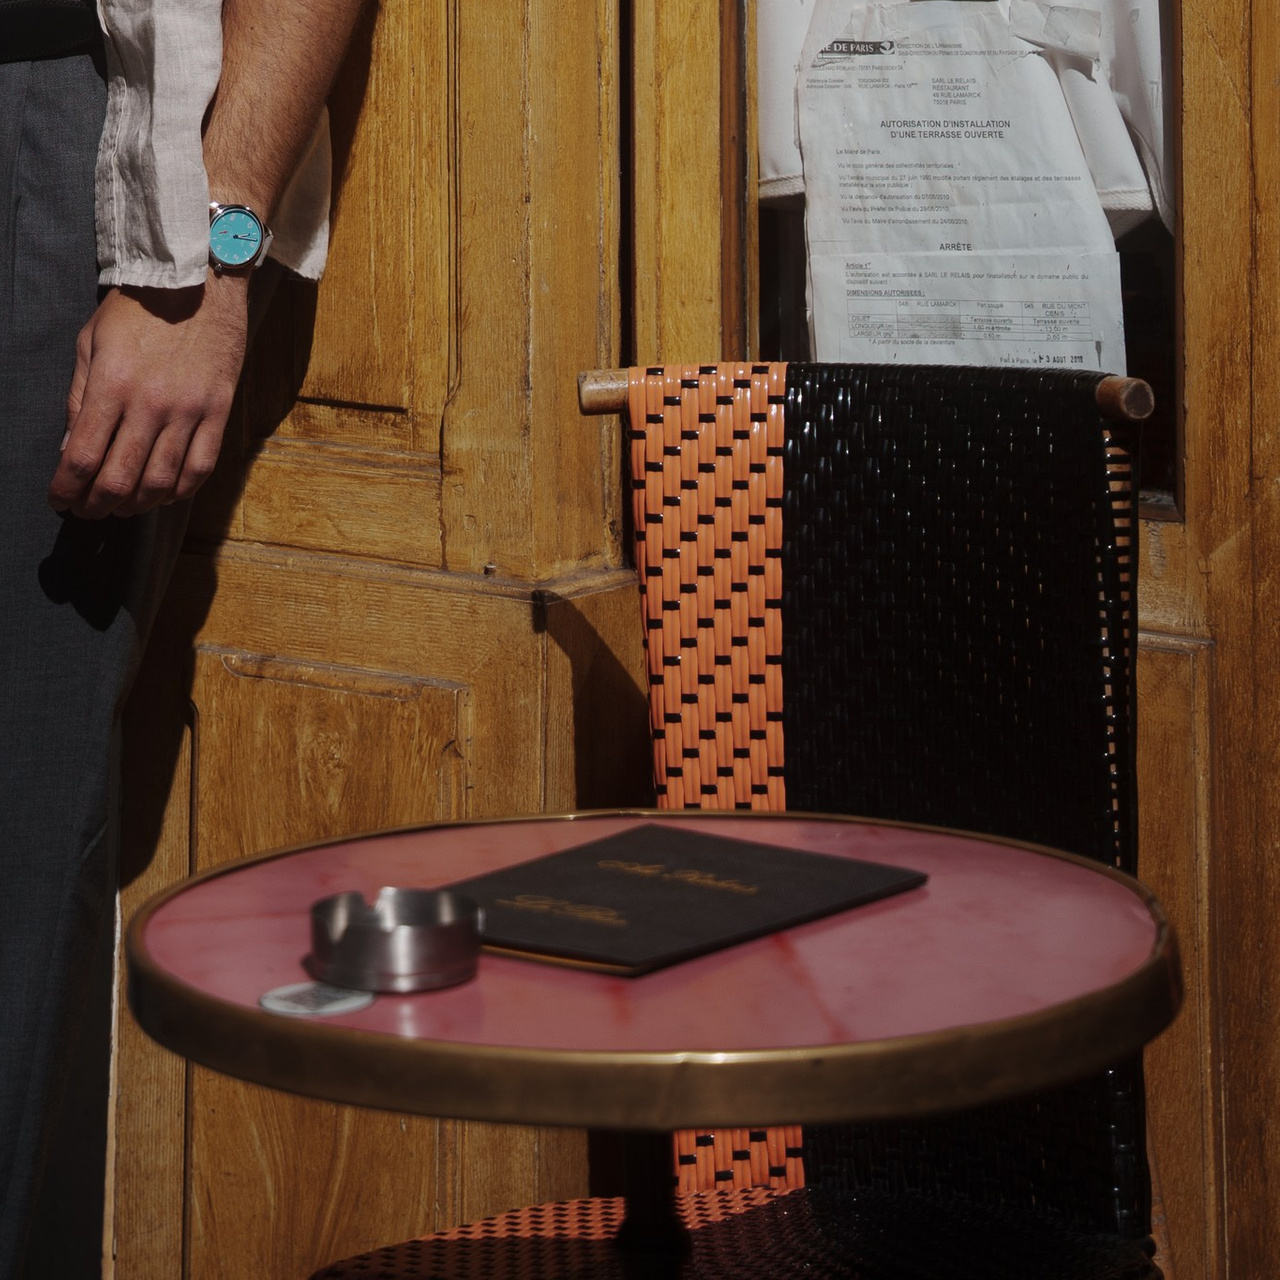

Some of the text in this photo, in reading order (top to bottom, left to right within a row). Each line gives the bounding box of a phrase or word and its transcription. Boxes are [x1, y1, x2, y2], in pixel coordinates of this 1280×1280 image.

[834, 43, 848, 52] DE
[850, 43, 874, 53] PARIS
[939, 242, 972, 251] ARRÊTE
